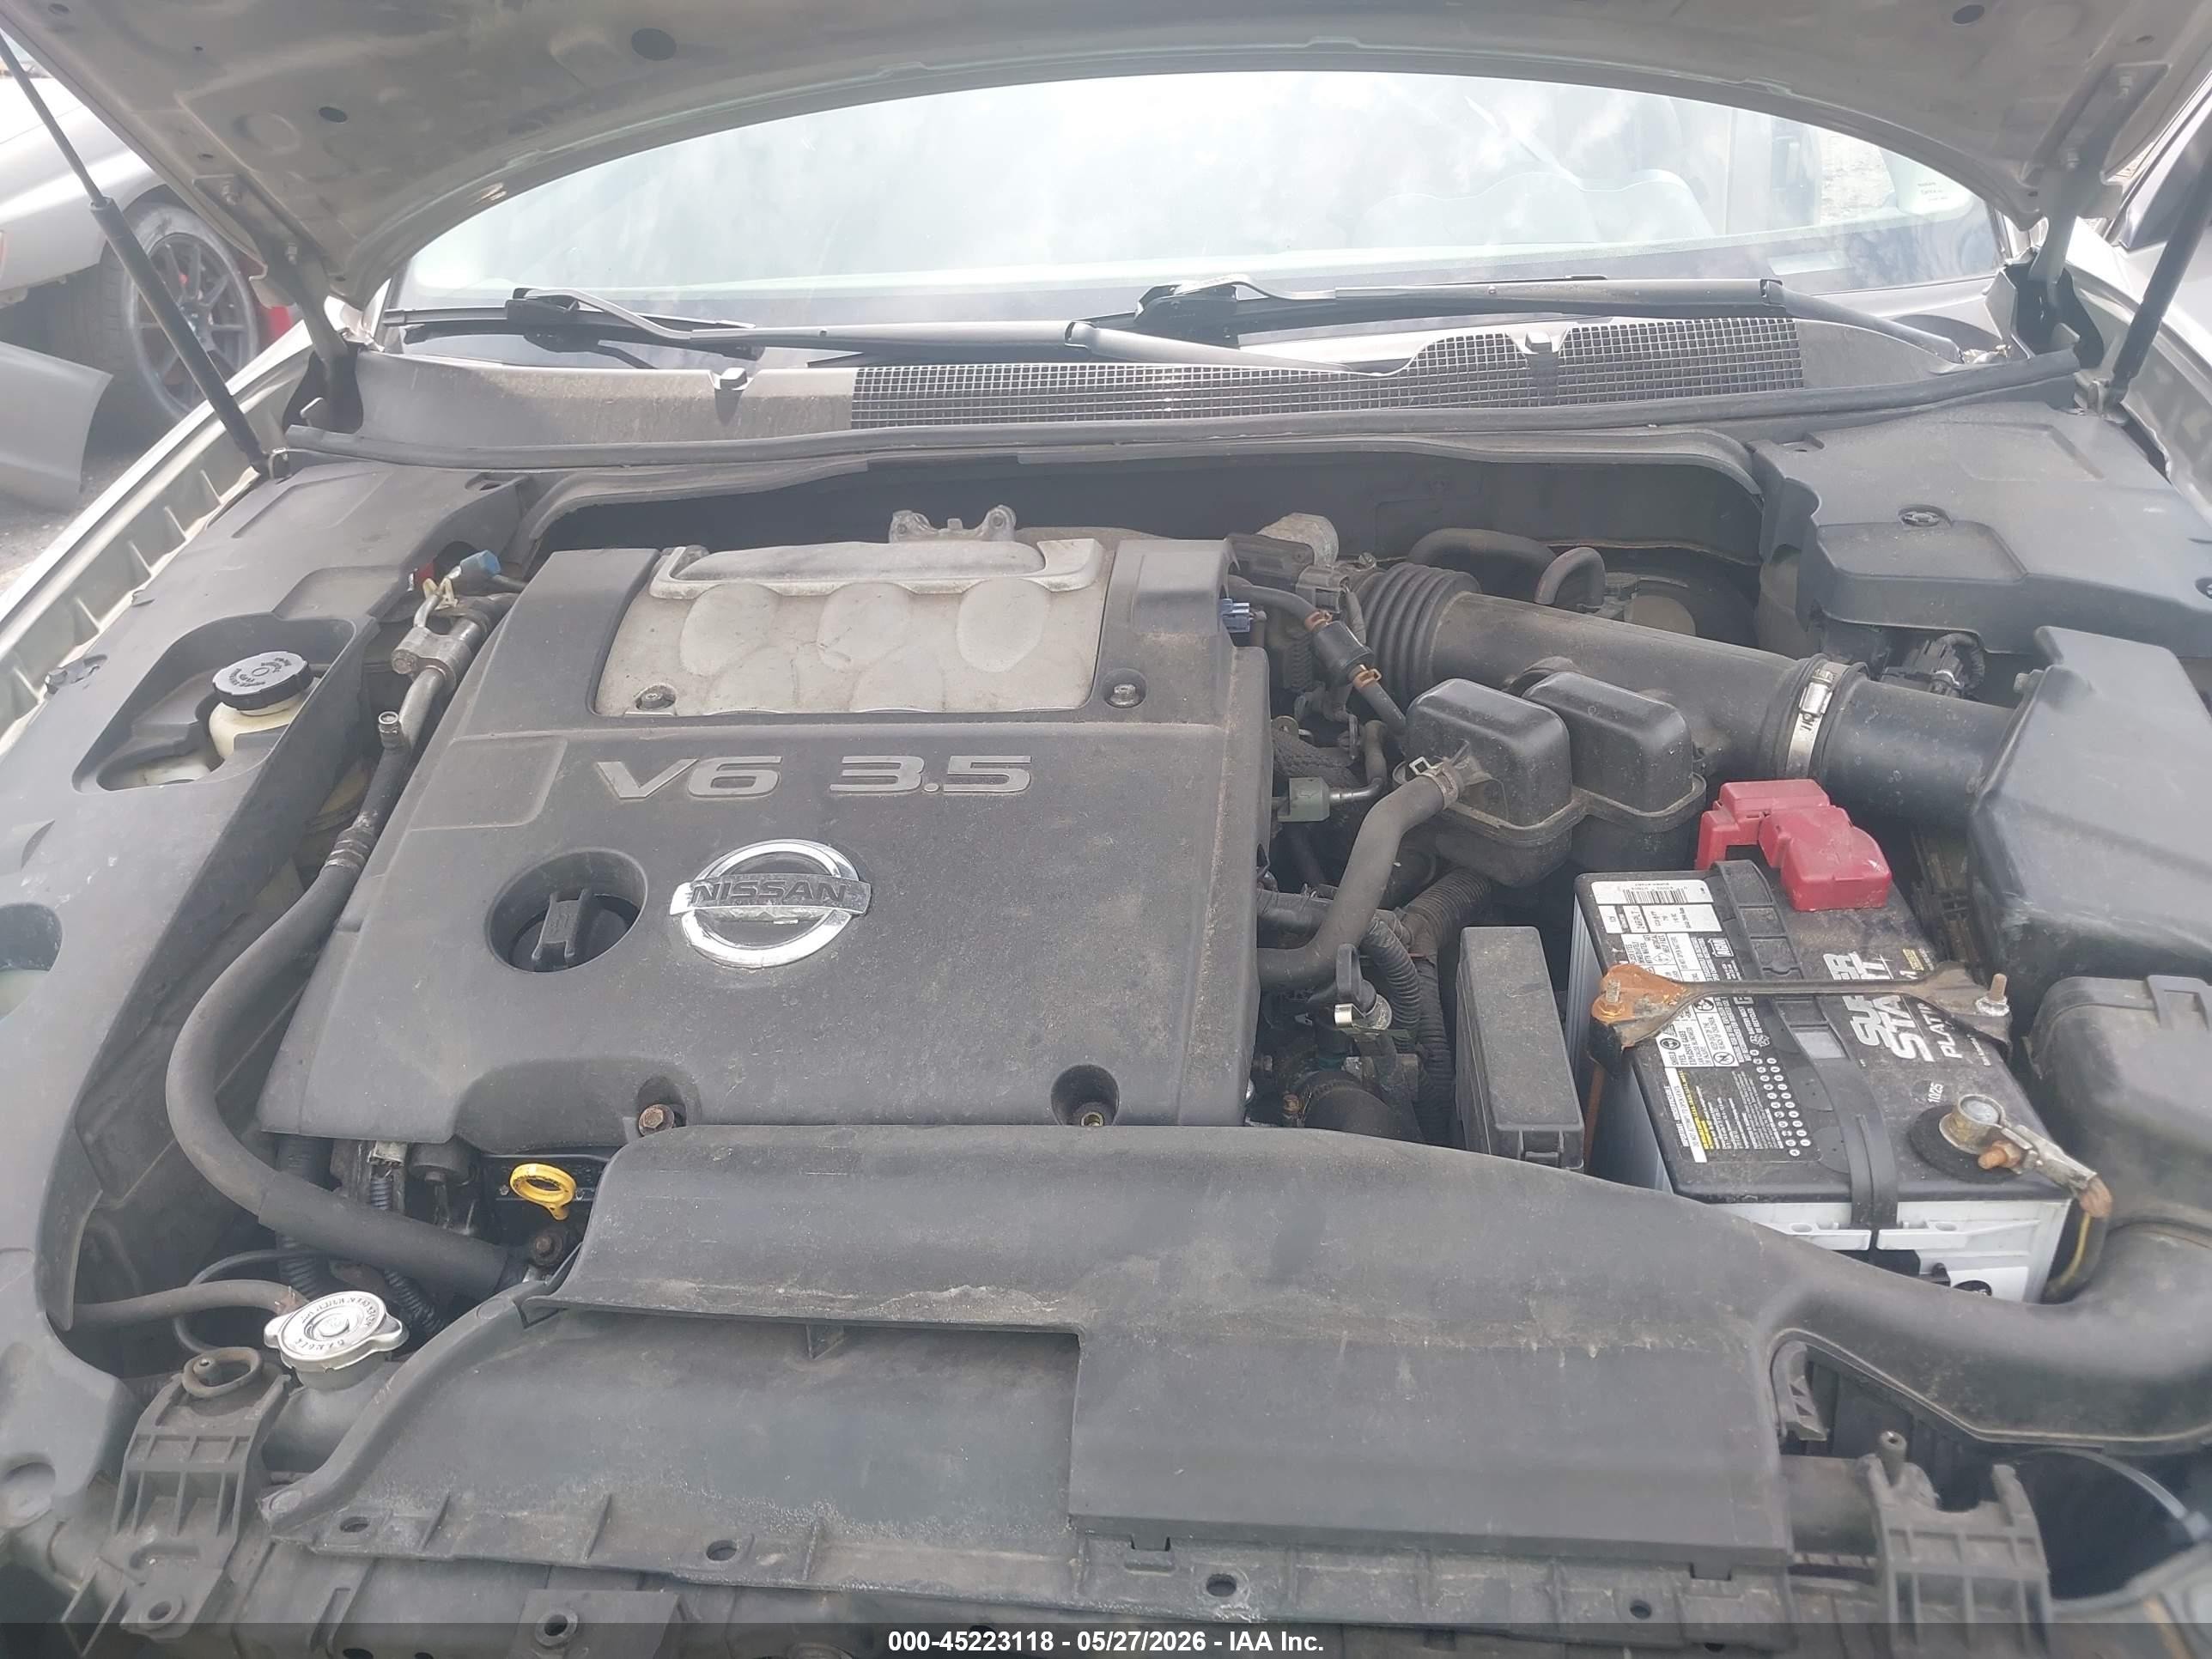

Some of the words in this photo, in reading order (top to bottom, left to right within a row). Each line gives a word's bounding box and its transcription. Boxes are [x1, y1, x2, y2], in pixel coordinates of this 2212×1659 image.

[595, 755, 783, 799] V6
[829, 755, 1033, 793] 3.5
[690, 878, 849, 905] NISSAN
[1716, 939, 1731, 956] AGM
[1849, 951, 1935, 1062] STAT
